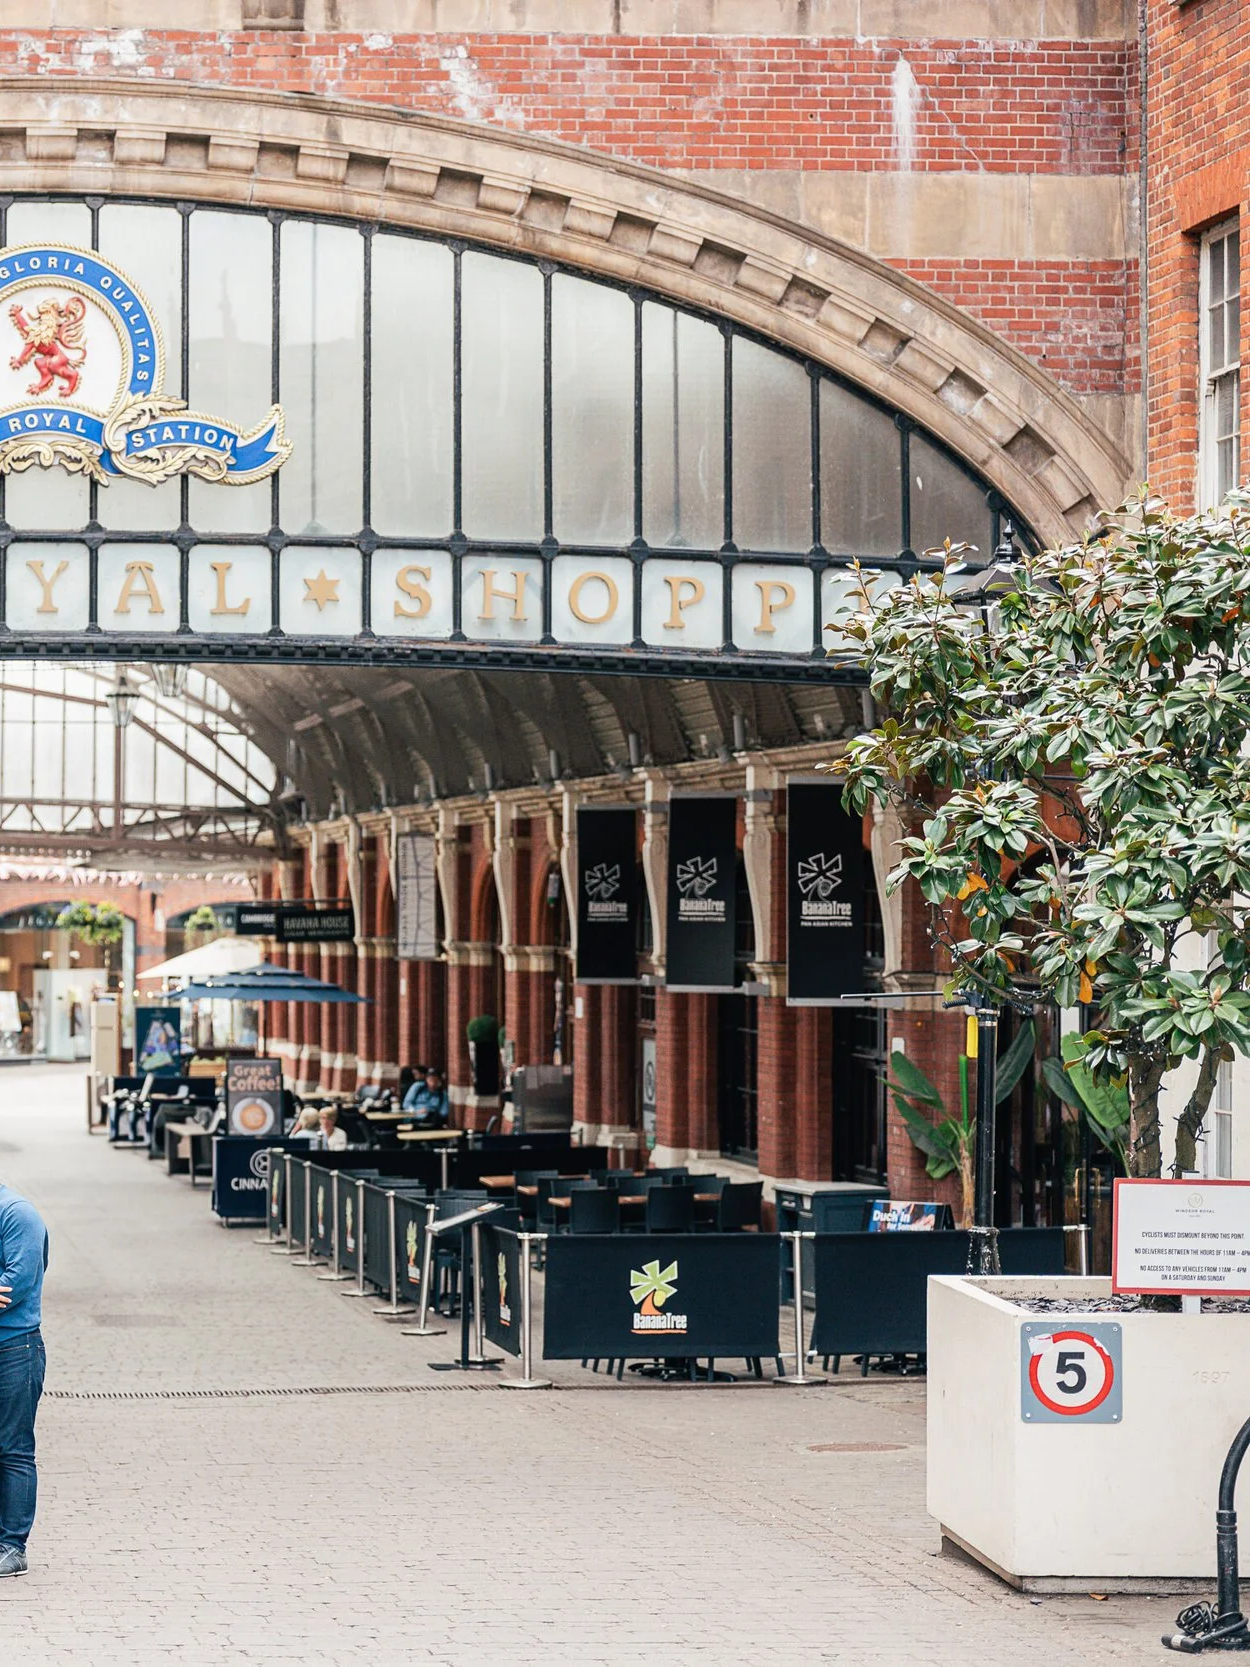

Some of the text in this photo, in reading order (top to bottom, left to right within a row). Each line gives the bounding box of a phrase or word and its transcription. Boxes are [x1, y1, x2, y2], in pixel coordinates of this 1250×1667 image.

[100, 276, 151, 381] QUALITAS
[7, 411, 88, 435] ROYAL
[131, 423, 237, 450] STATION
[679, 898, 726, 912] BananaTree
[802, 900, 852, 916] BananaTree
[283, 917, 320, 929] HAVANA
[320, 915, 350, 929] HOUSE
[234, 1065, 271, 1077] Great
[228, 1075, 282, 1092] Coffee!
[872, 1208, 898, 1223] Duck
[633, 1312, 687, 1330] BananaTree
[1055, 1351, 1088, 1394] 5
